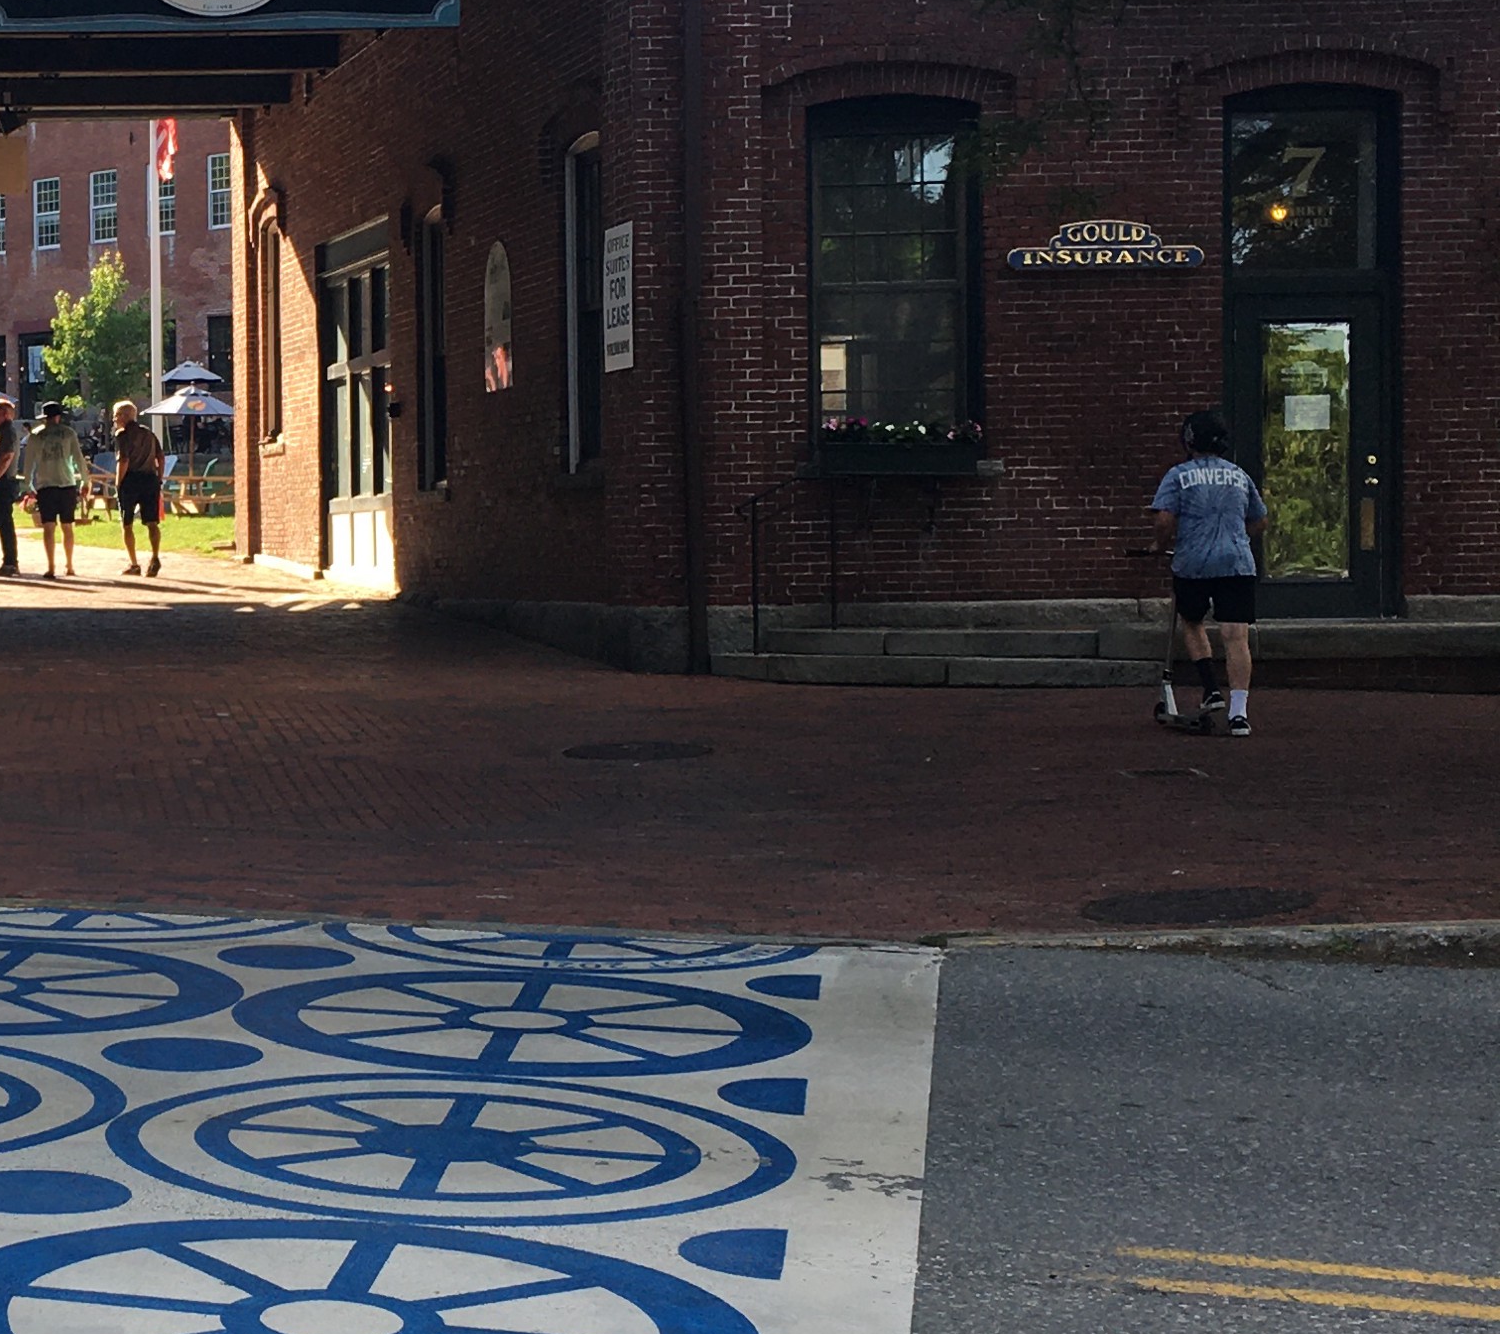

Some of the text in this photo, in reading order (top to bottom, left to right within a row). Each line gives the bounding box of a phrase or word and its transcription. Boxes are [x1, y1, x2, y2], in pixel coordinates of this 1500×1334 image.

[1282, 146, 1326, 197] 7
[606, 233, 630, 254] OFFICE
[1067, 223, 1146, 242] GOULD
[605, 254, 630, 277] SUITES
[1022, 248, 1191, 265] INSURANCE
[609, 276, 627, 300] FOR
[606, 303, 630, 330] LEASE
[1178, 467, 1250, 494] CONVERSE
